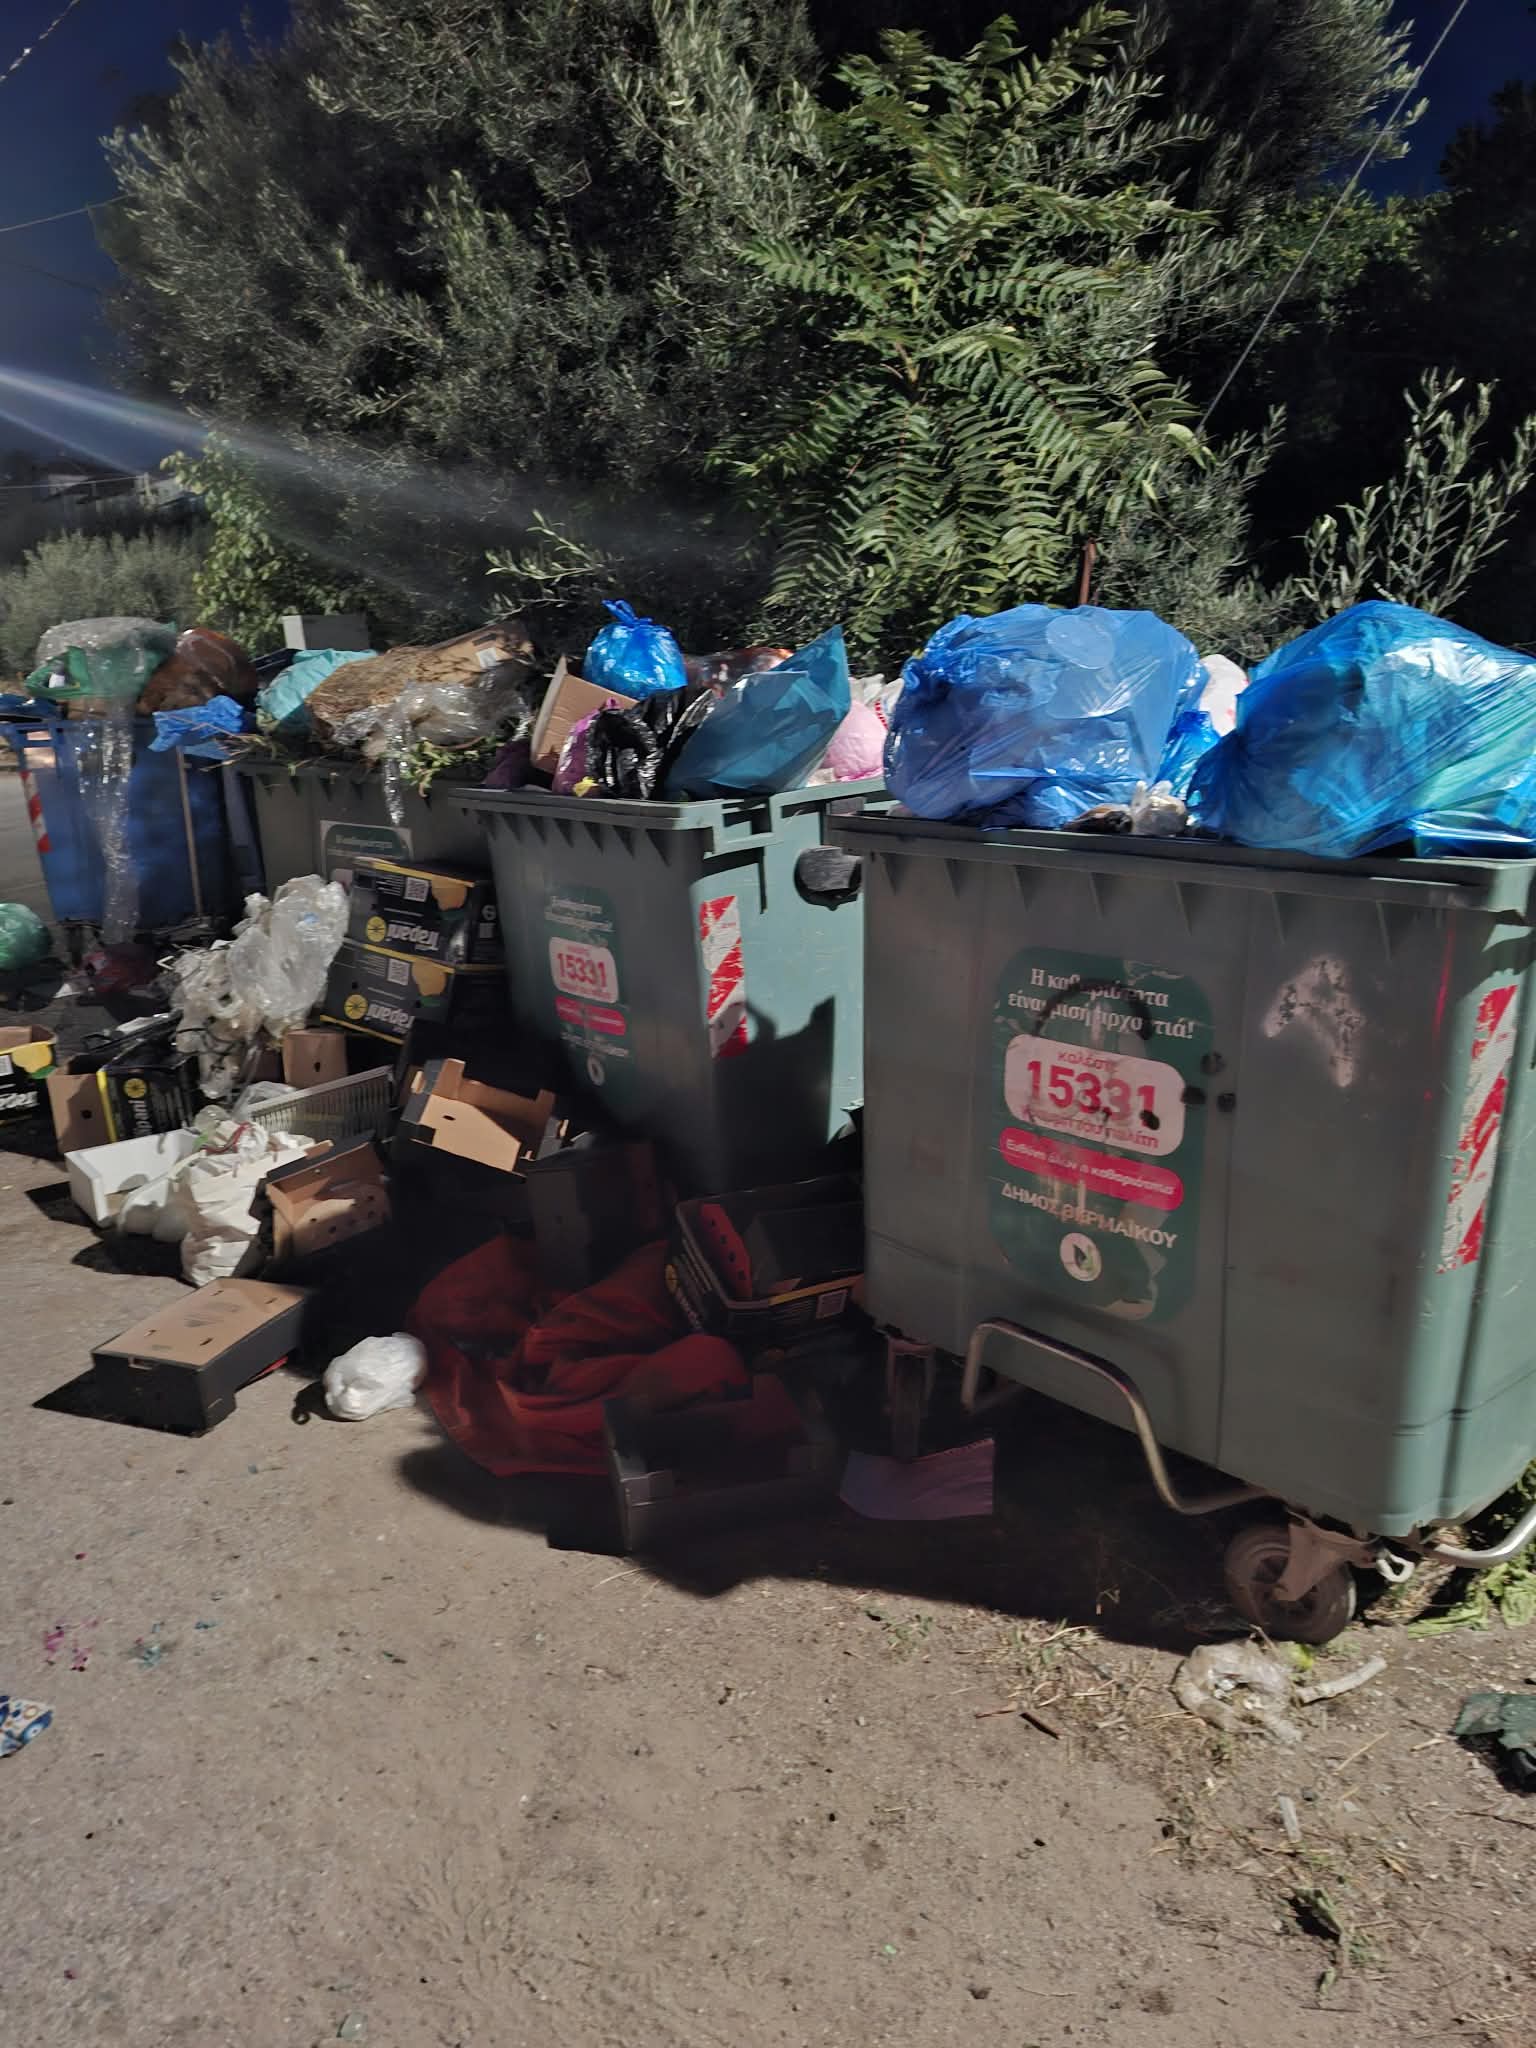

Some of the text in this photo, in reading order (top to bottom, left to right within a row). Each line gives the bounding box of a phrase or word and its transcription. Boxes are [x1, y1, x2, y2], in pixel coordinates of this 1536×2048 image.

[556, 952, 607, 987] 15331
[1030, 968, 1046, 987] Η
[1096, 1011, 1195, 1040] αρχοτιά!
[1026, 1060, 1159, 1130] 15331
